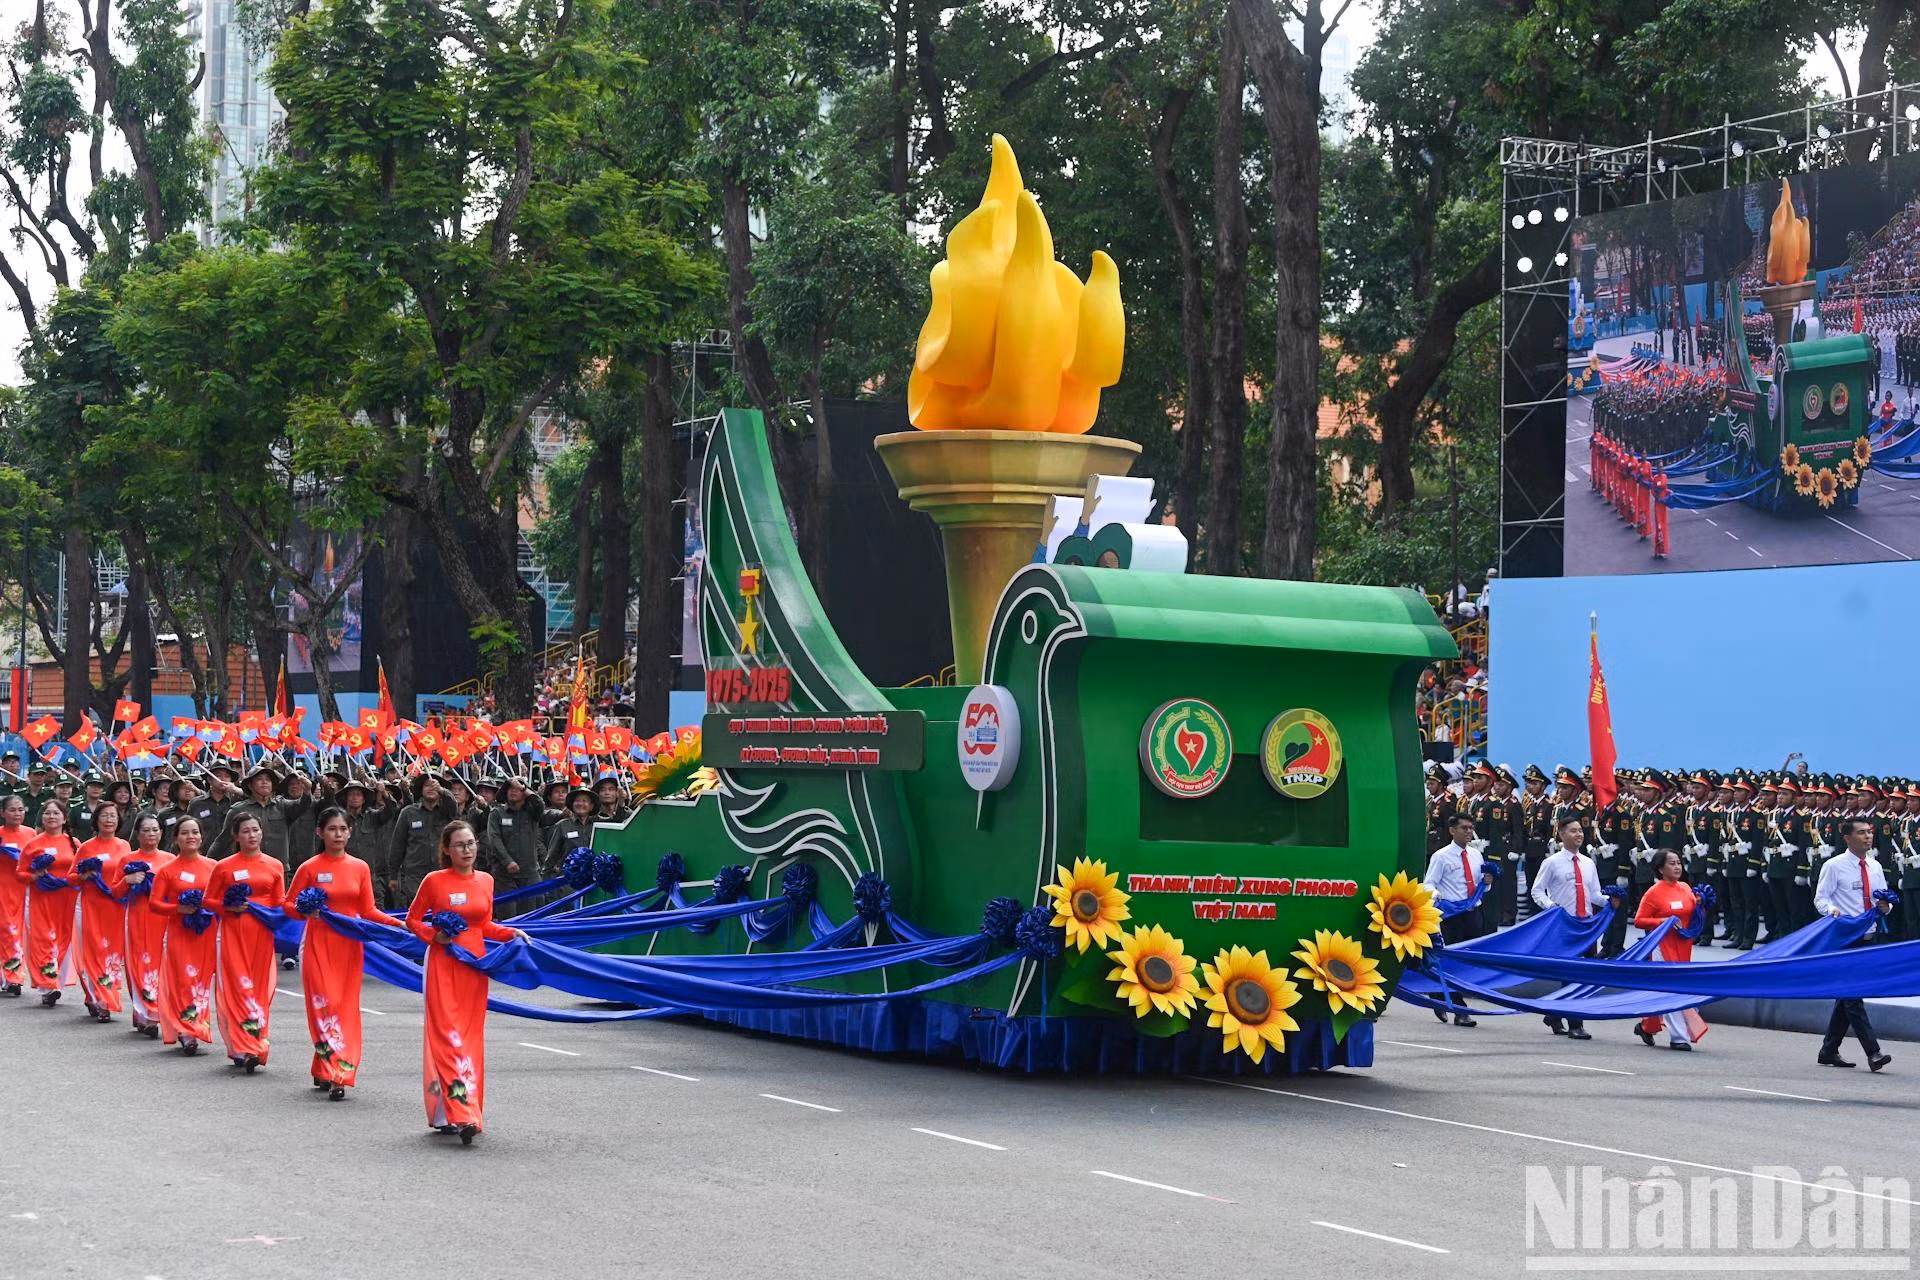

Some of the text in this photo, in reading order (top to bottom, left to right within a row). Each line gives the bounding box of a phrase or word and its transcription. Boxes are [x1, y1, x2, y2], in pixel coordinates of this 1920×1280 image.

[707, 667, 791, 703] 1975-2025
[1284, 773, 1324, 785] TNXP
[1128, 873, 1358, 897] THANH NIÊN XUNG PHONG
[1192, 899, 1276, 923] VIỆT NAM
